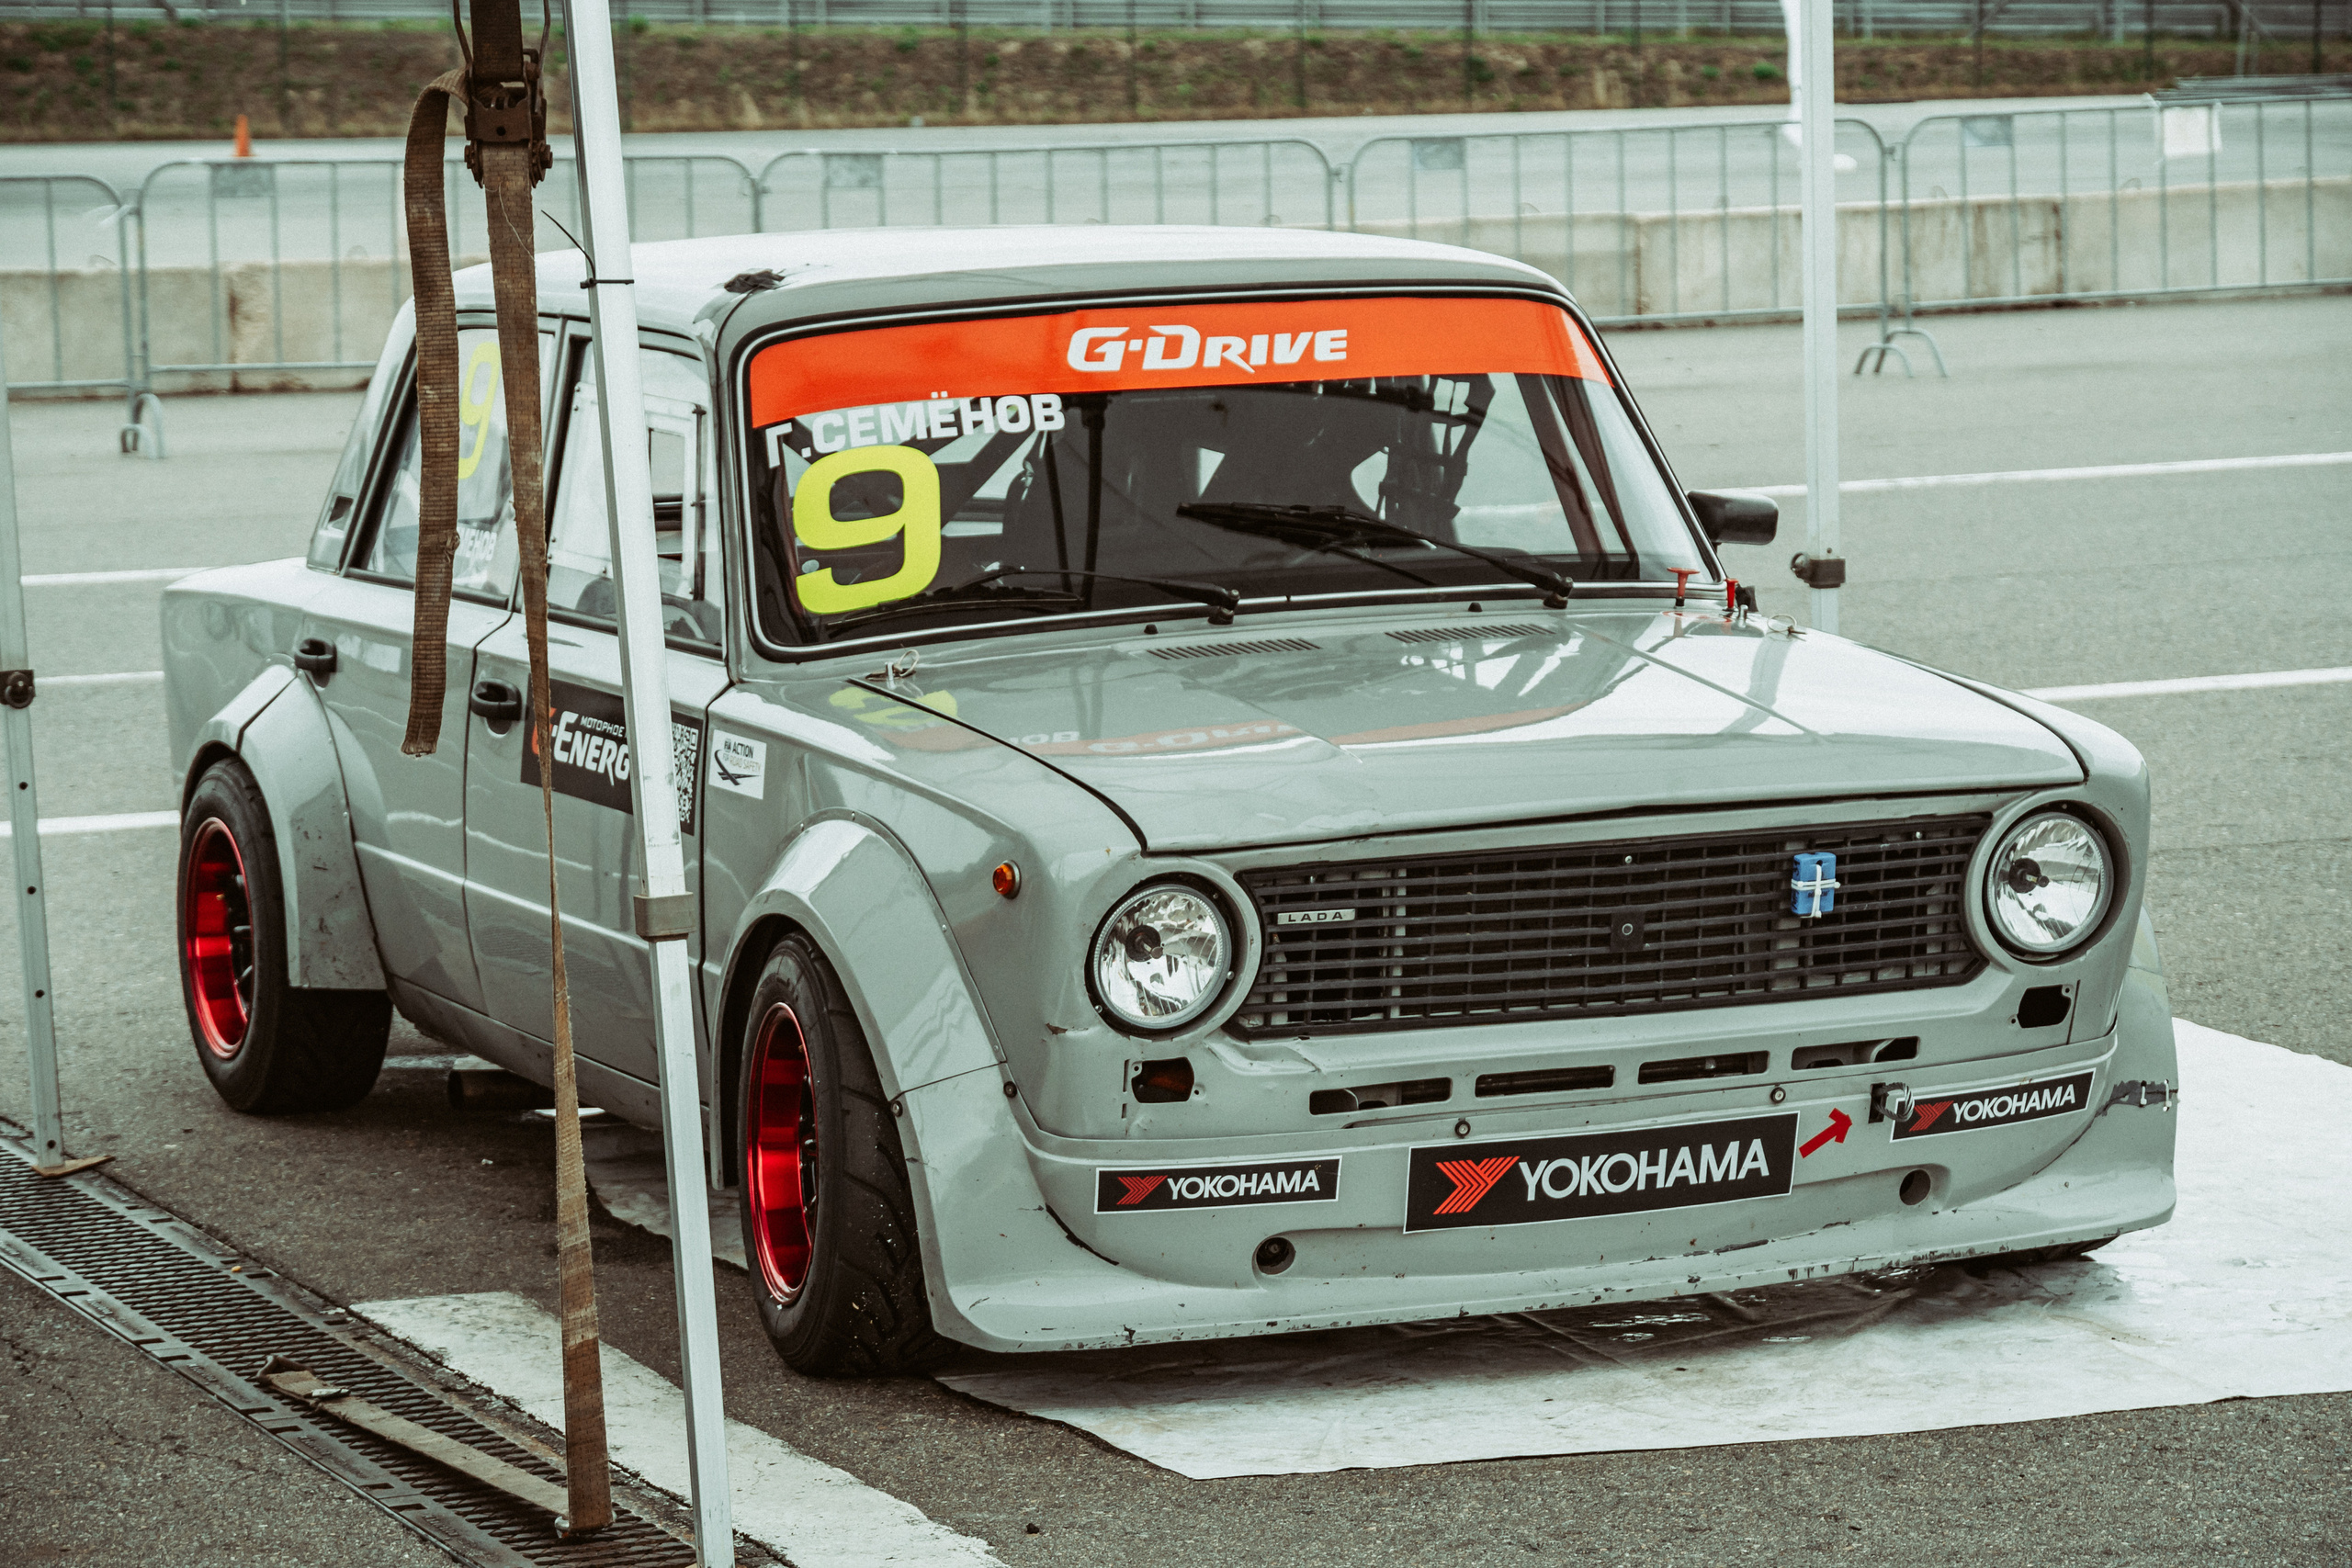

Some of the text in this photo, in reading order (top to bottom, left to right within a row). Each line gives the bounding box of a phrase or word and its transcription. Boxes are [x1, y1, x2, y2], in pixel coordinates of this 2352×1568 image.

[1067, 324, 1348, 374] G-DRIVE
[765, 390, 1066, 469] Г.СЕМЁНОВ
[793, 446, 942, 615] 9
[580, 716, 626, 738] МОТОРНОЕ
[732, 741, 754, 759] ACTION
[743, 758, 762, 772] SAFETY
[1288, 912, 1343, 923] LADA
[1953, 1084, 2075, 1123] YOKOHAMA
[1167, 1169, 1320, 1200] YOKOHAMA
[1518, 1138, 1770, 1201] YOKOHAMA
